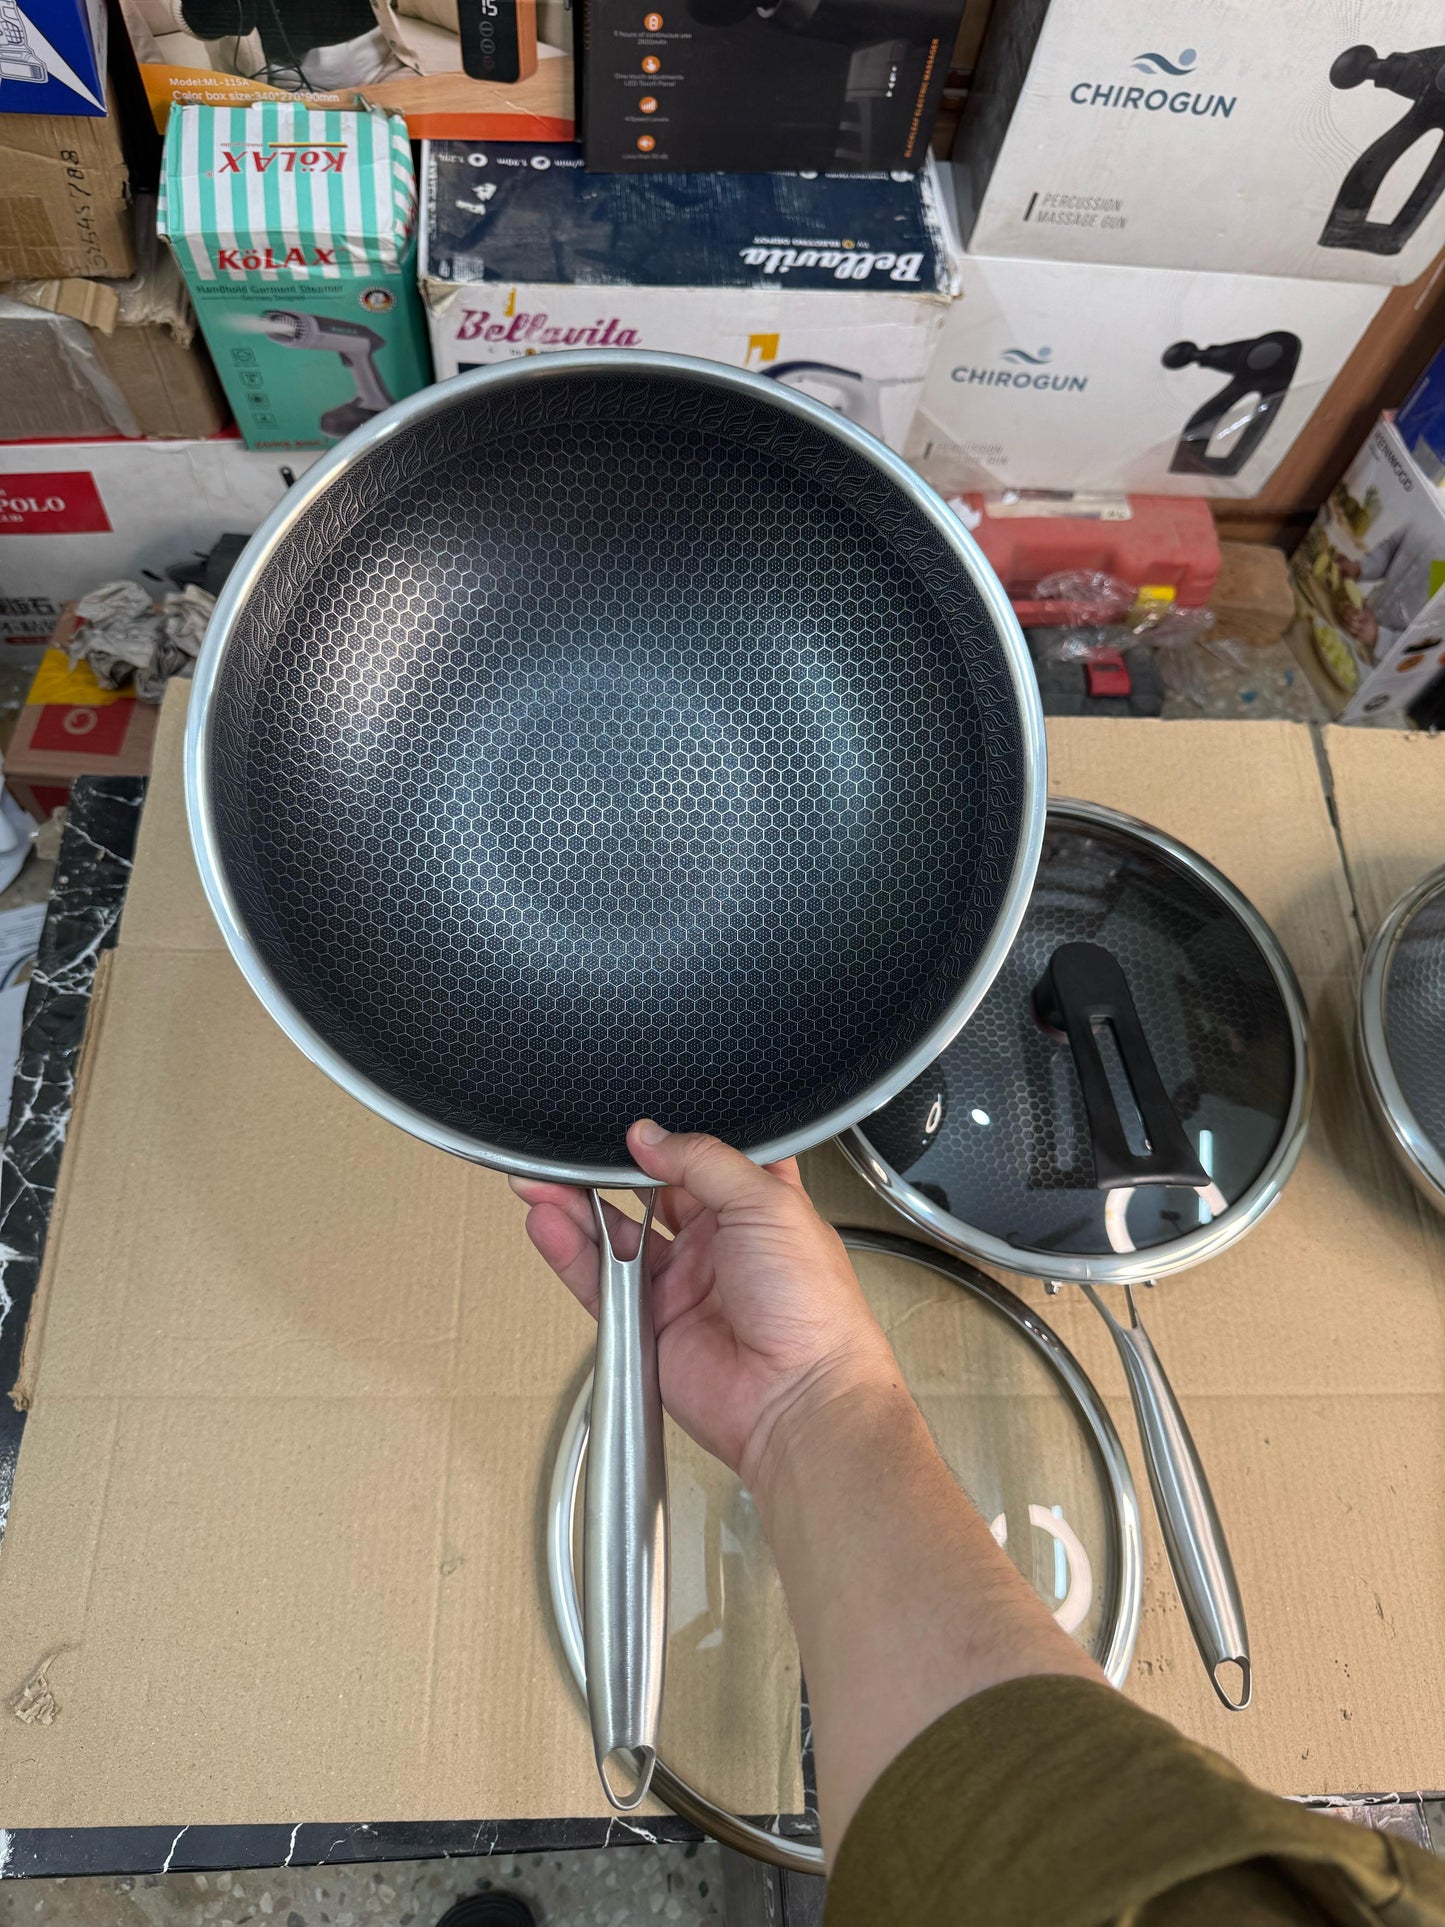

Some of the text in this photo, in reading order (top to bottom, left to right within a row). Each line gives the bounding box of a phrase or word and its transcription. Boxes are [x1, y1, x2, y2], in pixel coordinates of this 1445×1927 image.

[922, 38, 940, 81] MASSAGER
[205, 90, 226, 101] box
[1070, 82, 1237, 119] CHIROGUN
[1042, 191, 1124, 212] PERCUSSION
[1037, 209, 1129, 230] MASSAGE GUN
[218, 247, 336, 271] KöLAX
[738, 247, 926, 282] Bellavita
[455, 308, 643, 347] Bellavita
[950, 366, 1089, 393] CHIROGUN
